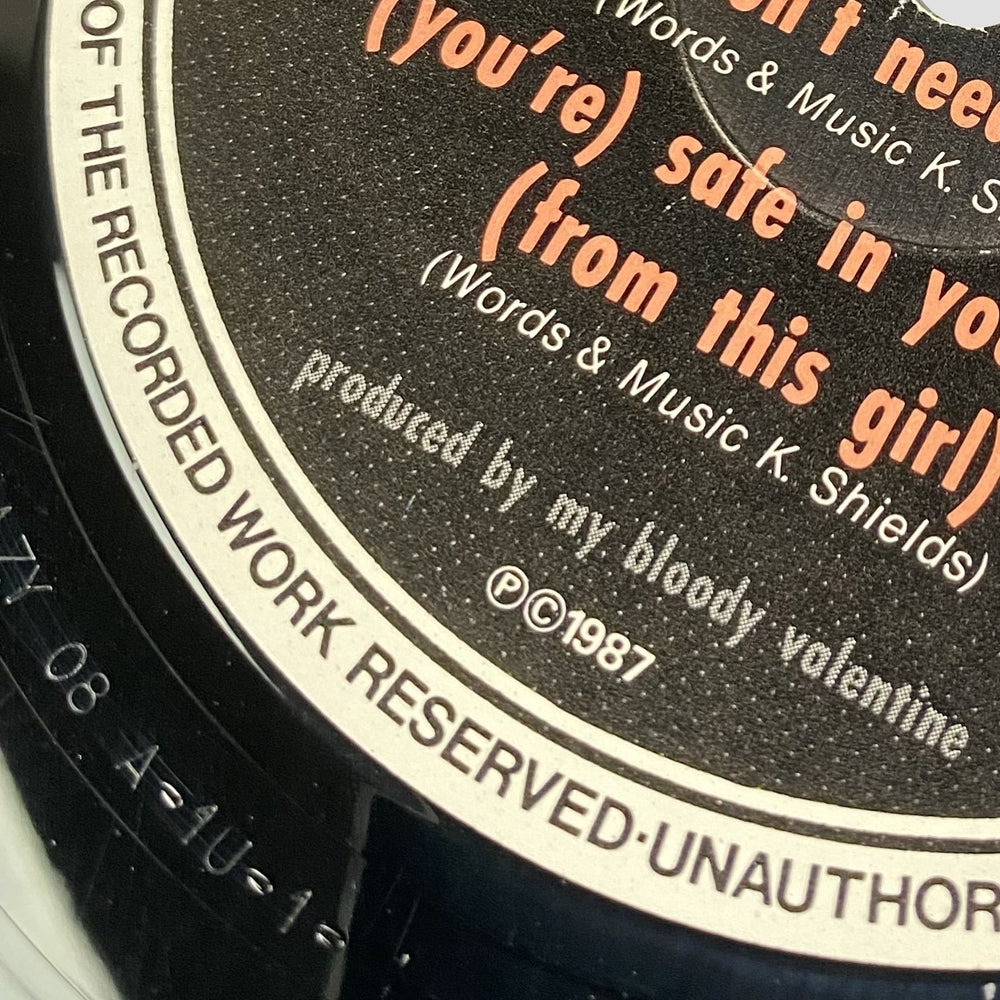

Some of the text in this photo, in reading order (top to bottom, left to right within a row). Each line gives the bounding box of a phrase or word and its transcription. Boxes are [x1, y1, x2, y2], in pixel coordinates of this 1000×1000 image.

[80, 84, 129, 197] THE
[746, 61, 779, 95] &
[788, 82, 912, 166] Music
[920, 152, 961, 193] K.
[481, 161, 678, 324] (from
[696, 287, 830, 406] this
[654, 134, 797, 240] safe
[817, 200, 892, 292] in
[91, 205, 234, 496] RECORDED
[420, 249, 990, 593] (Words & Music K. Shields)
[217, 490, 358, 659] WORK
[291, 348, 969, 762] produced by my bloody valentine
[45, 643, 109, 714] 08
